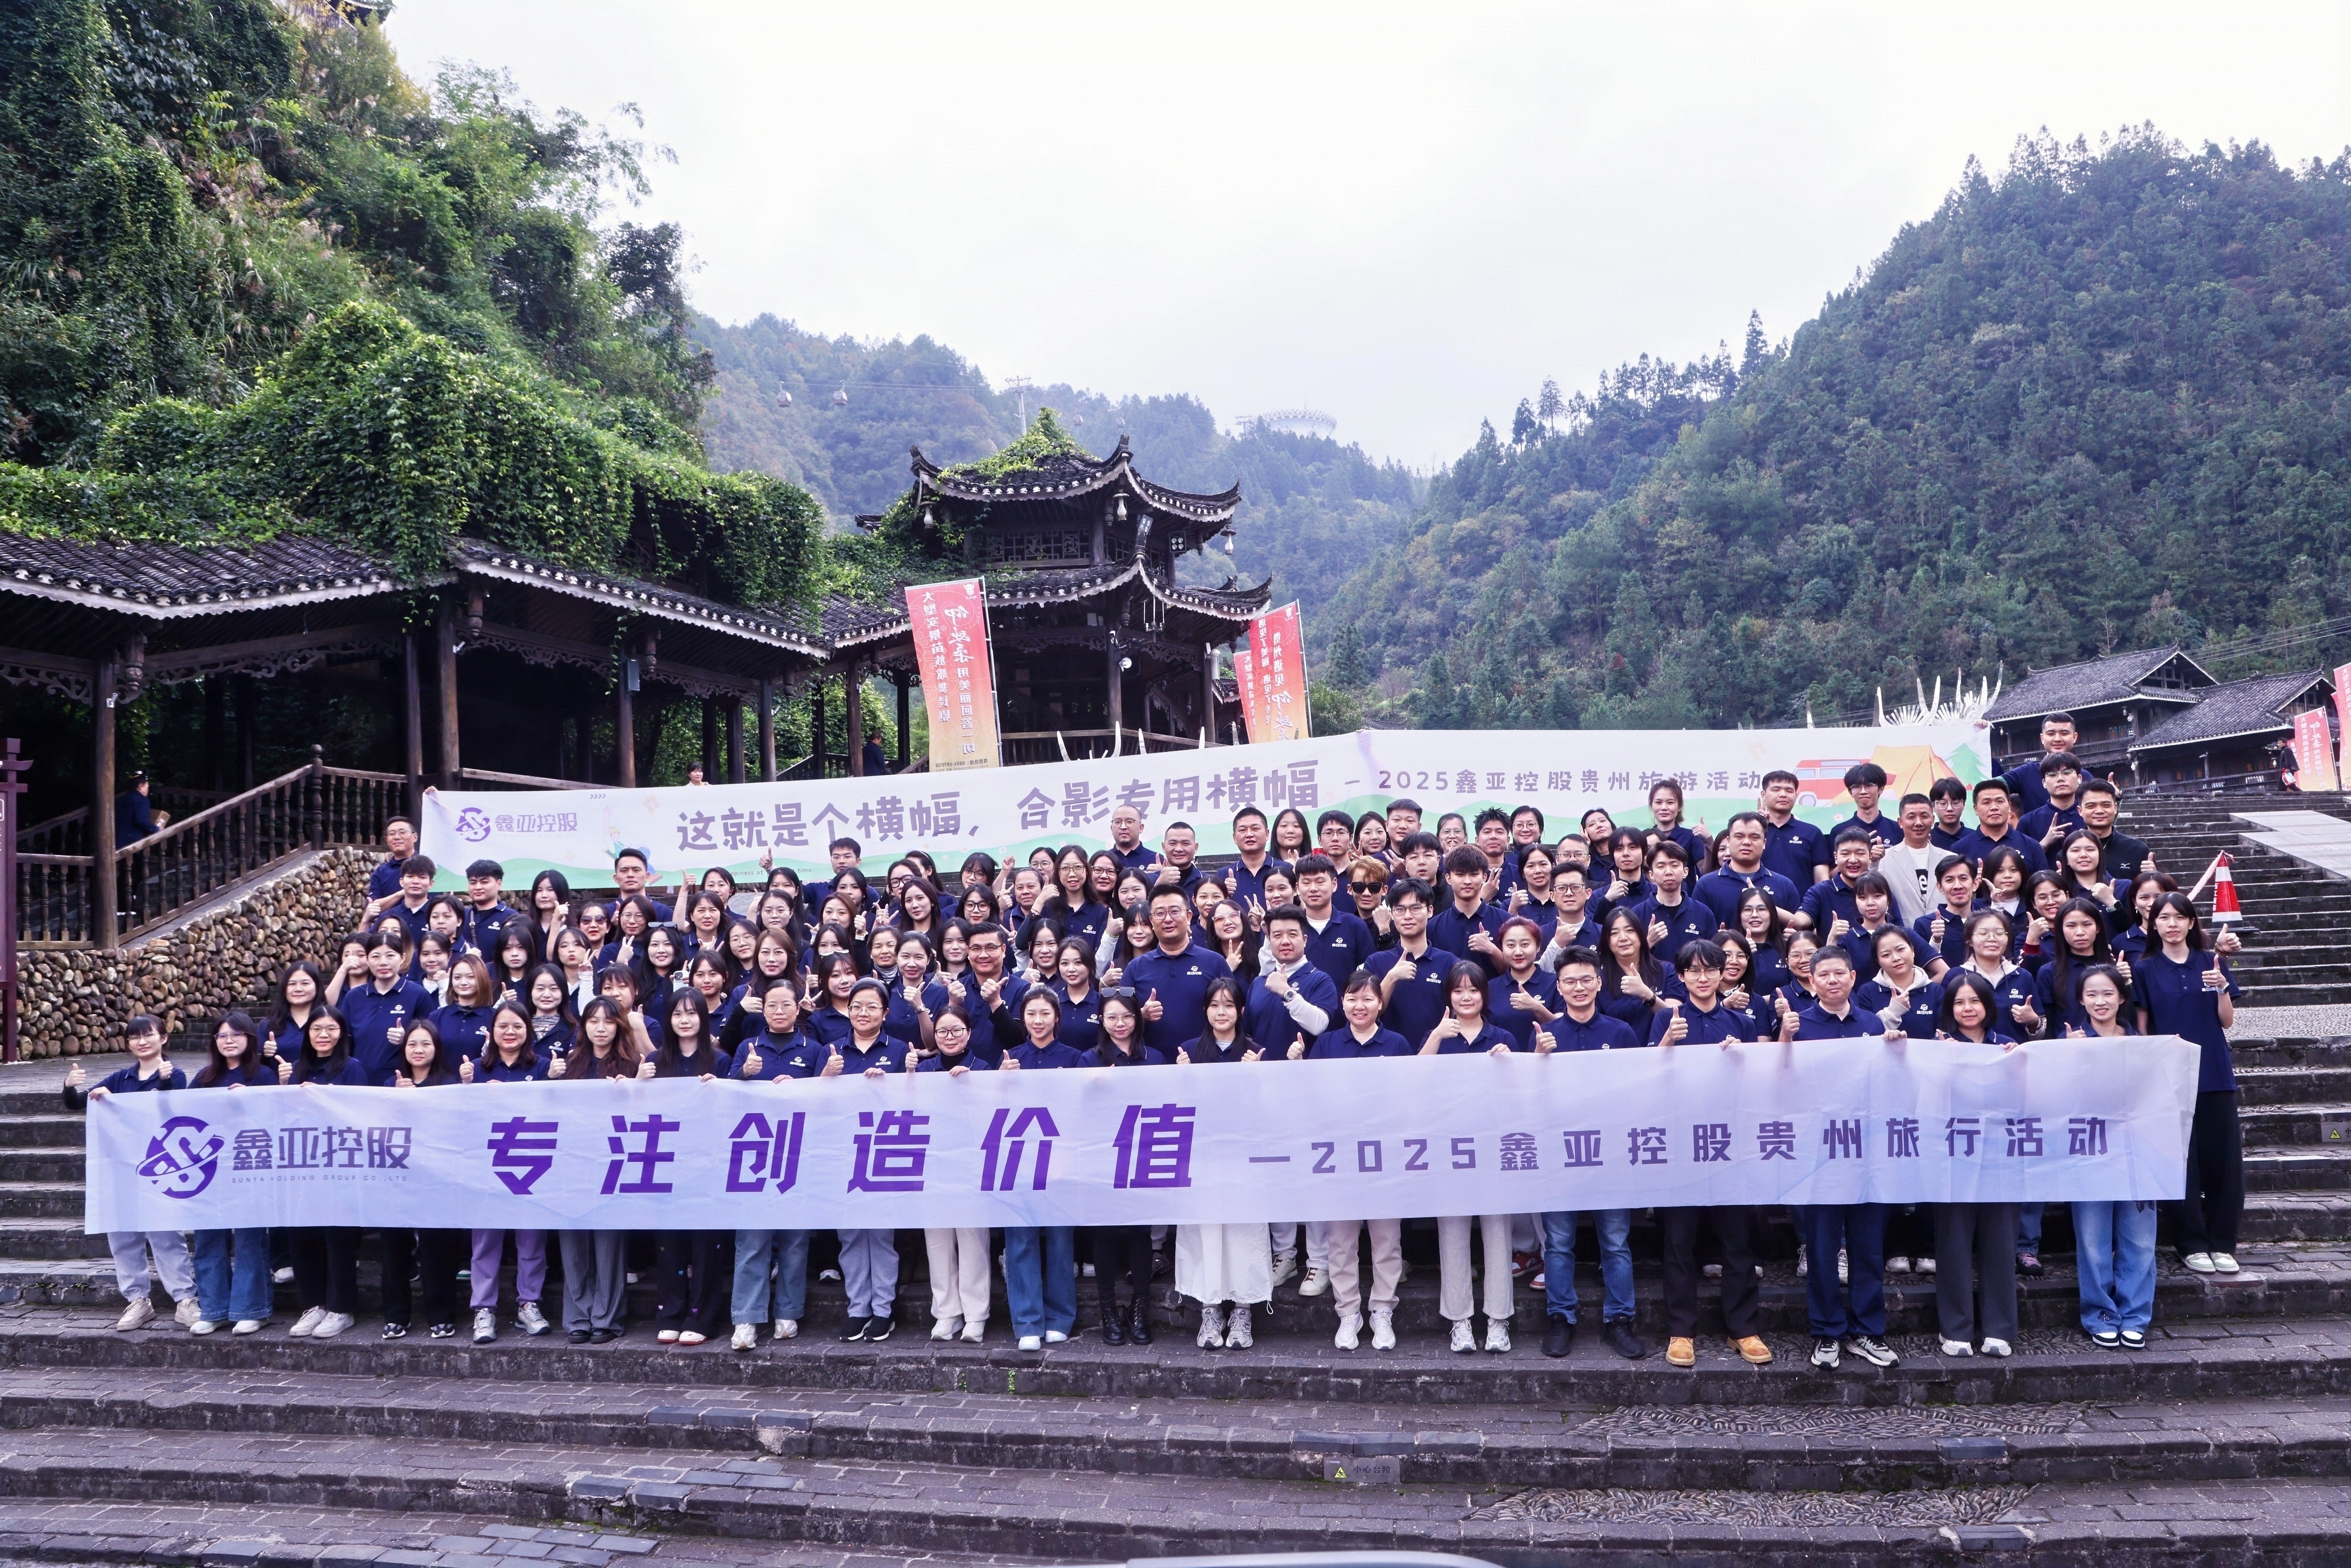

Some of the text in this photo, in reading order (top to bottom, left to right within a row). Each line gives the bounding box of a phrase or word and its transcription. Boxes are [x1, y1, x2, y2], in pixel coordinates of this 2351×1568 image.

[494, 813, 578, 833] 鑫亚控股
[232, 1126, 412, 1171] 鑫亚控股
[487, 1103, 1197, 1195] 专注创造价值
[1354, 1466, 1391, 1474] 小心台阶
